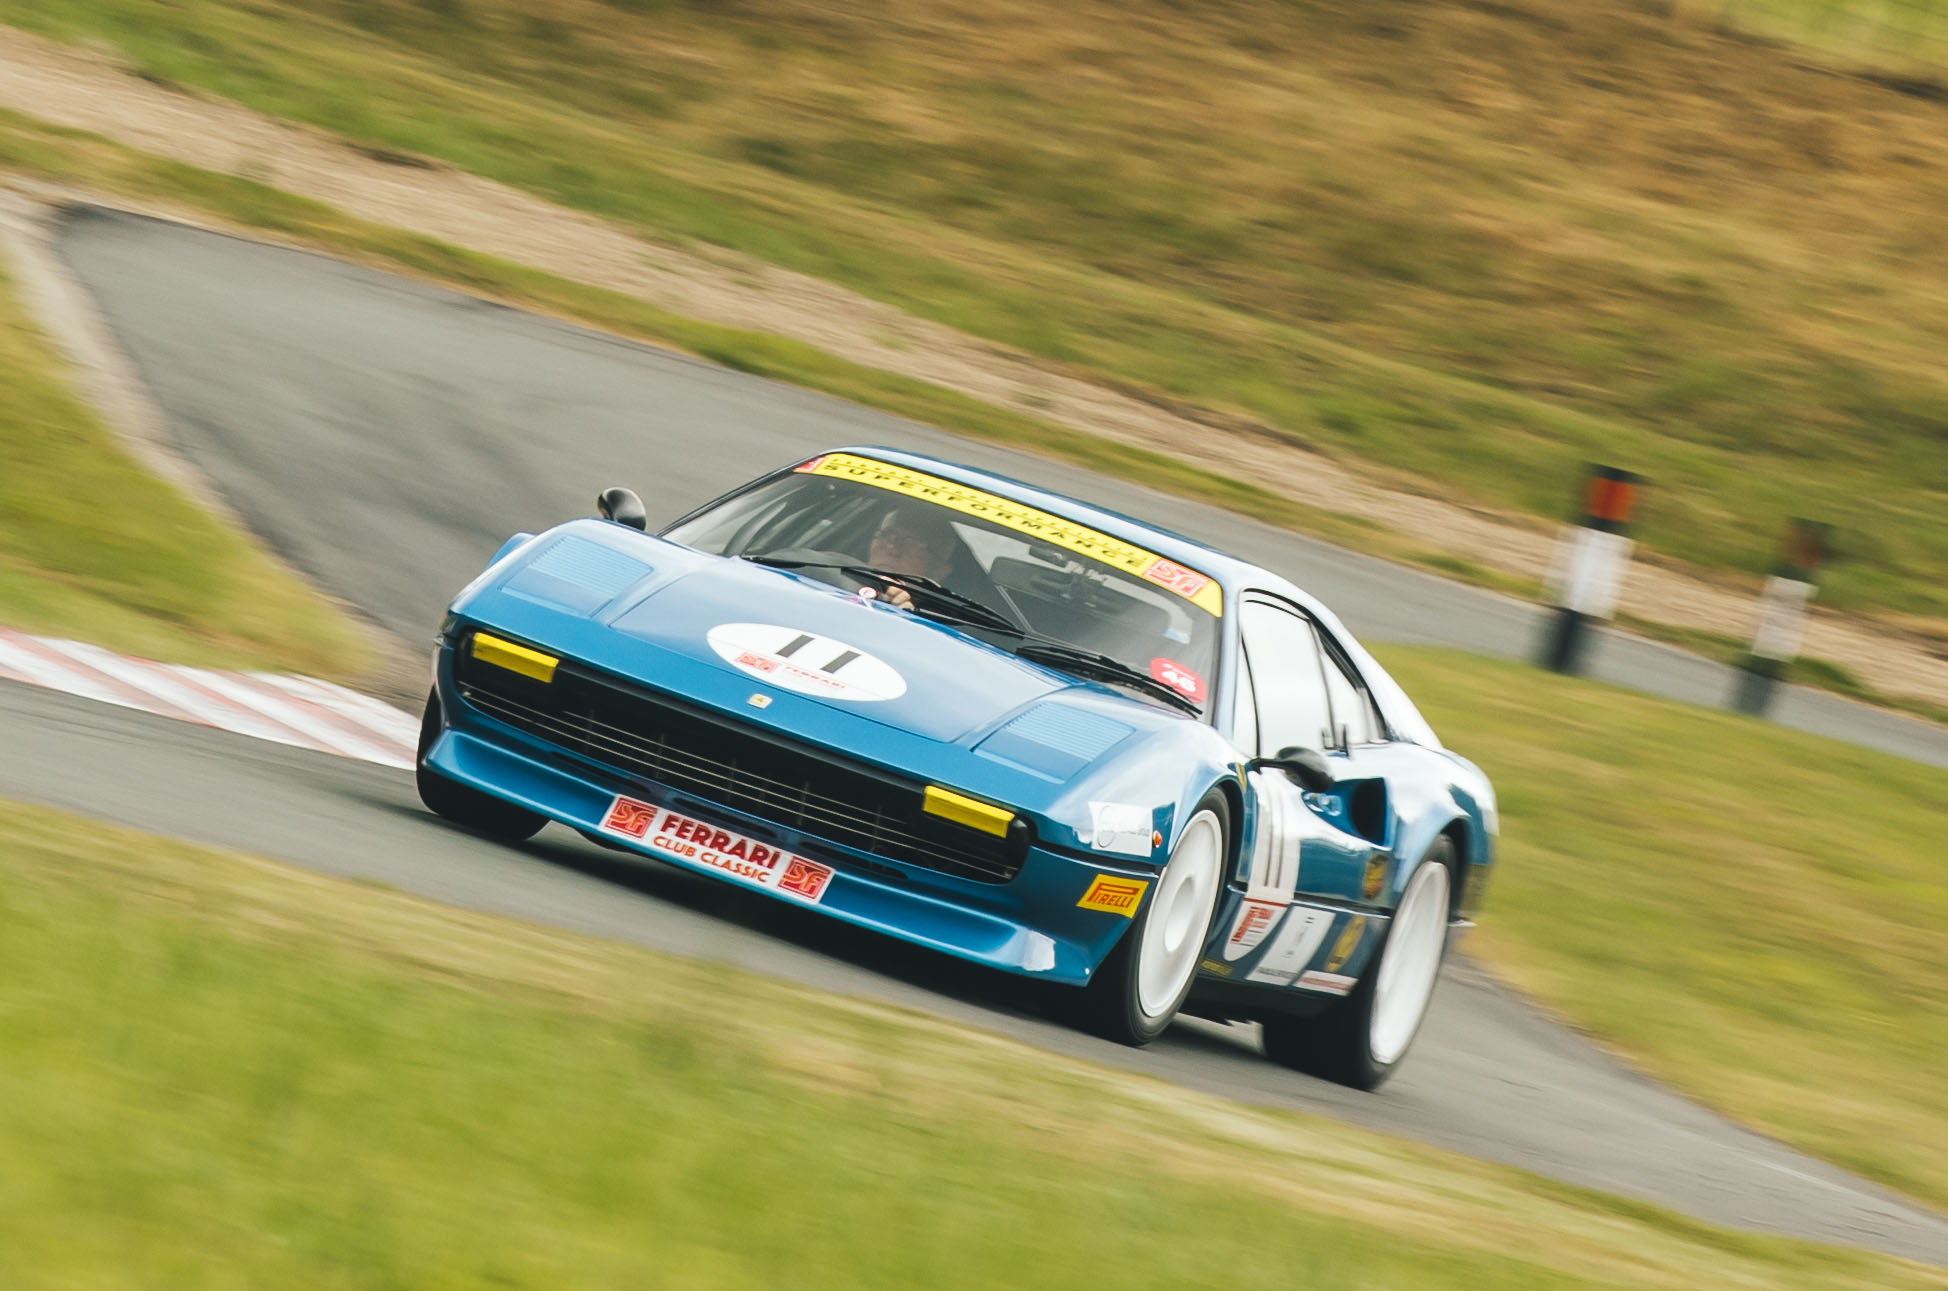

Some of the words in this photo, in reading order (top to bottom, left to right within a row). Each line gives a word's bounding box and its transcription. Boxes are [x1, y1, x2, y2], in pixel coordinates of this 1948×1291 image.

[823, 463, 1145, 568] SUPERFORMANCE
[775, 634, 862, 674] 11
[653, 835, 697, 858] CLUB
[700, 852, 771, 883] CLASSIC
[660, 814, 781, 870] FERRARI
[1086, 881, 1140, 909] PIRELLI
